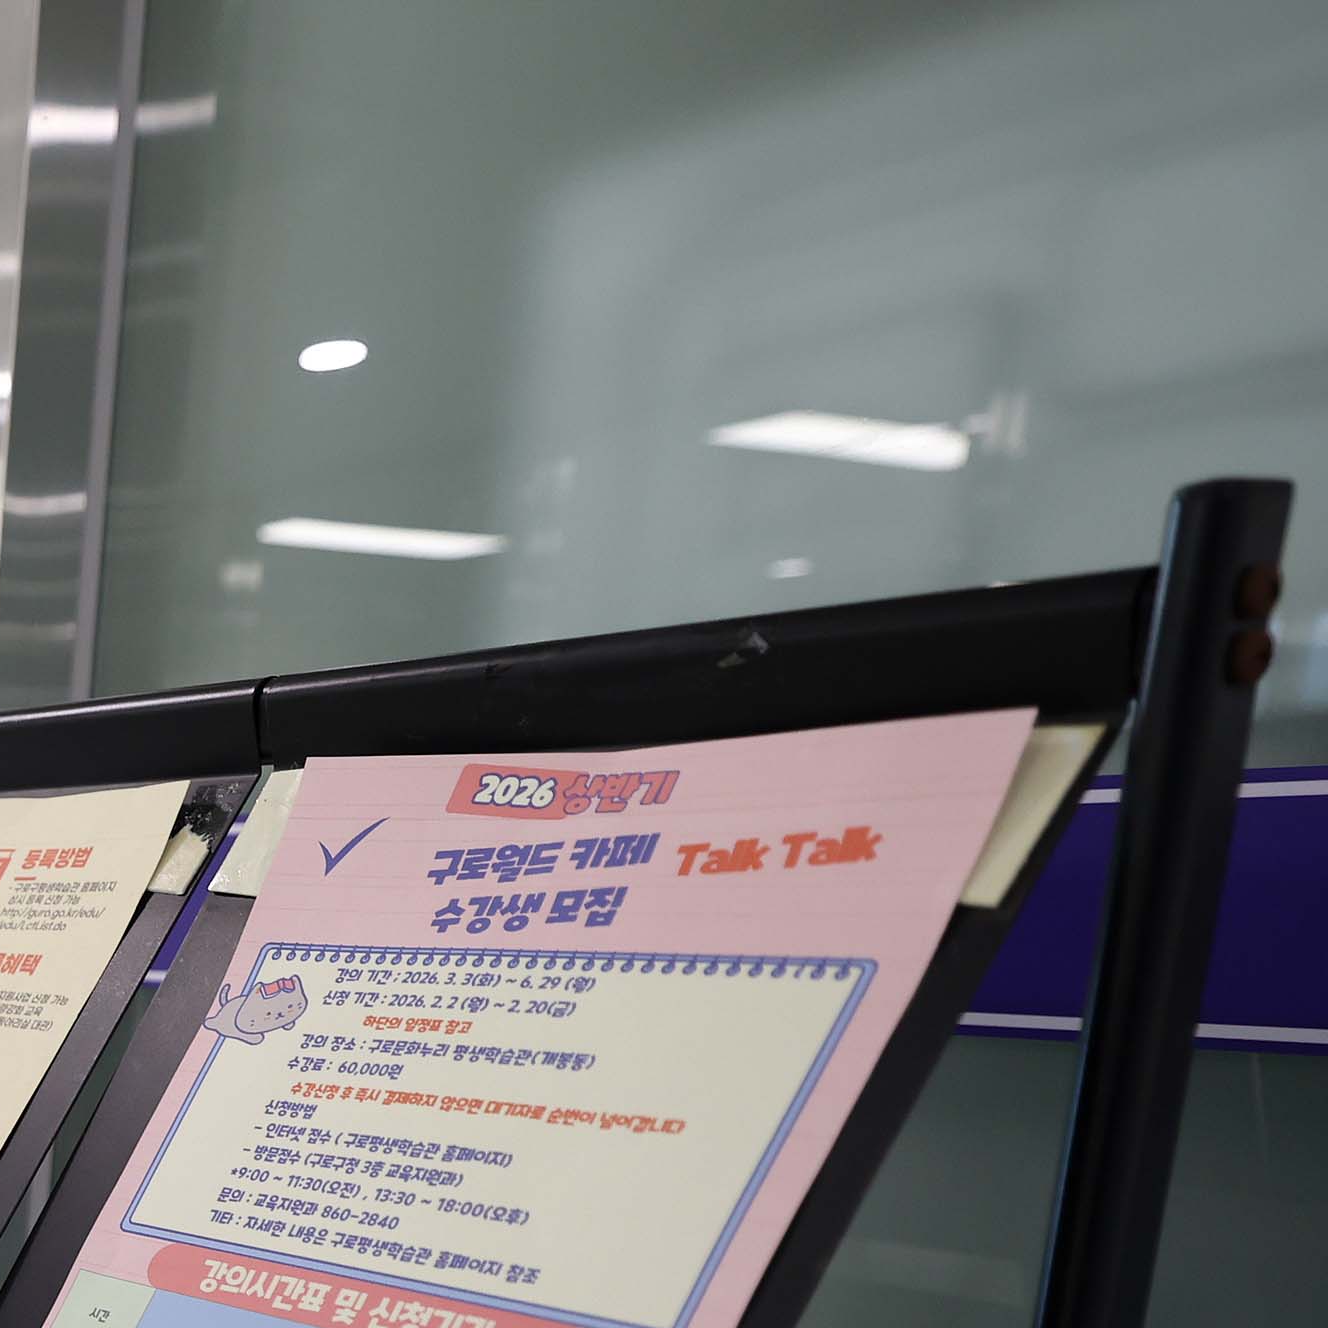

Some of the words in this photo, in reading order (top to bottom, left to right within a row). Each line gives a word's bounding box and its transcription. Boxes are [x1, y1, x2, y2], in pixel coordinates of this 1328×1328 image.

[472, 773, 556, 809] 2026
[561, 771, 680, 814] 상반기
[21, 847, 94, 870] 등록방법
[427, 841, 565, 886] 구로월드
[569, 832, 661, 870] 카페
[677, 838, 771, 876] Talk
[781, 825, 883, 868] Talk
[431, 892, 545, 934] 수강생
[545, 886, 629, 927] 모집
[335, 968, 363, 983] 강의
[368, 968, 393, 984] 기간
[401, 972, 439, 985] 2026.
[539, 976, 561, 989] 29
[362, 1016, 401, 1030] 하단의
[405, 1018, 444, 1032] 일정표
[446, 1020, 472, 1034] 참고
[300, 1034, 328, 1048] 강의
[331, 1036, 356, 1050] 장소
[368, 1039, 450, 1057] 구로문화누리
[338, 1061, 404, 1080] 60,000원
[265, 1100, 317, 1119] 신청방법
[253, 1145, 301, 1165] 방문접수
[304, 1153, 360, 1174] (구로구청
[361, 1164, 386, 1178] 3층
[385, 1166, 464, 1188] 교육지원과)
[217, 1188, 245, 1204] 문의
[254, 1193, 318, 1217] 교육지원과
[320, 1206, 400, 1230] 860-2840
[374, 1188, 416, 1206] 13:30
[437, 1198, 530, 1226] 18:00(오후)
[209, 1210, 234, 1225] 기타
[243, 1216, 287, 1238] 자세한
[288, 1225, 329, 1247] 내용은
[330, 1233, 433, 1265] 구로평생학습관
[433, 1250, 504, 1278] 홈페이지
[505, 1263, 541, 1286] 참조
[199, 1259, 331, 1313] 강의시간표
[331, 1287, 368, 1325] 및
[88, 1306, 111, 1324] 시간
